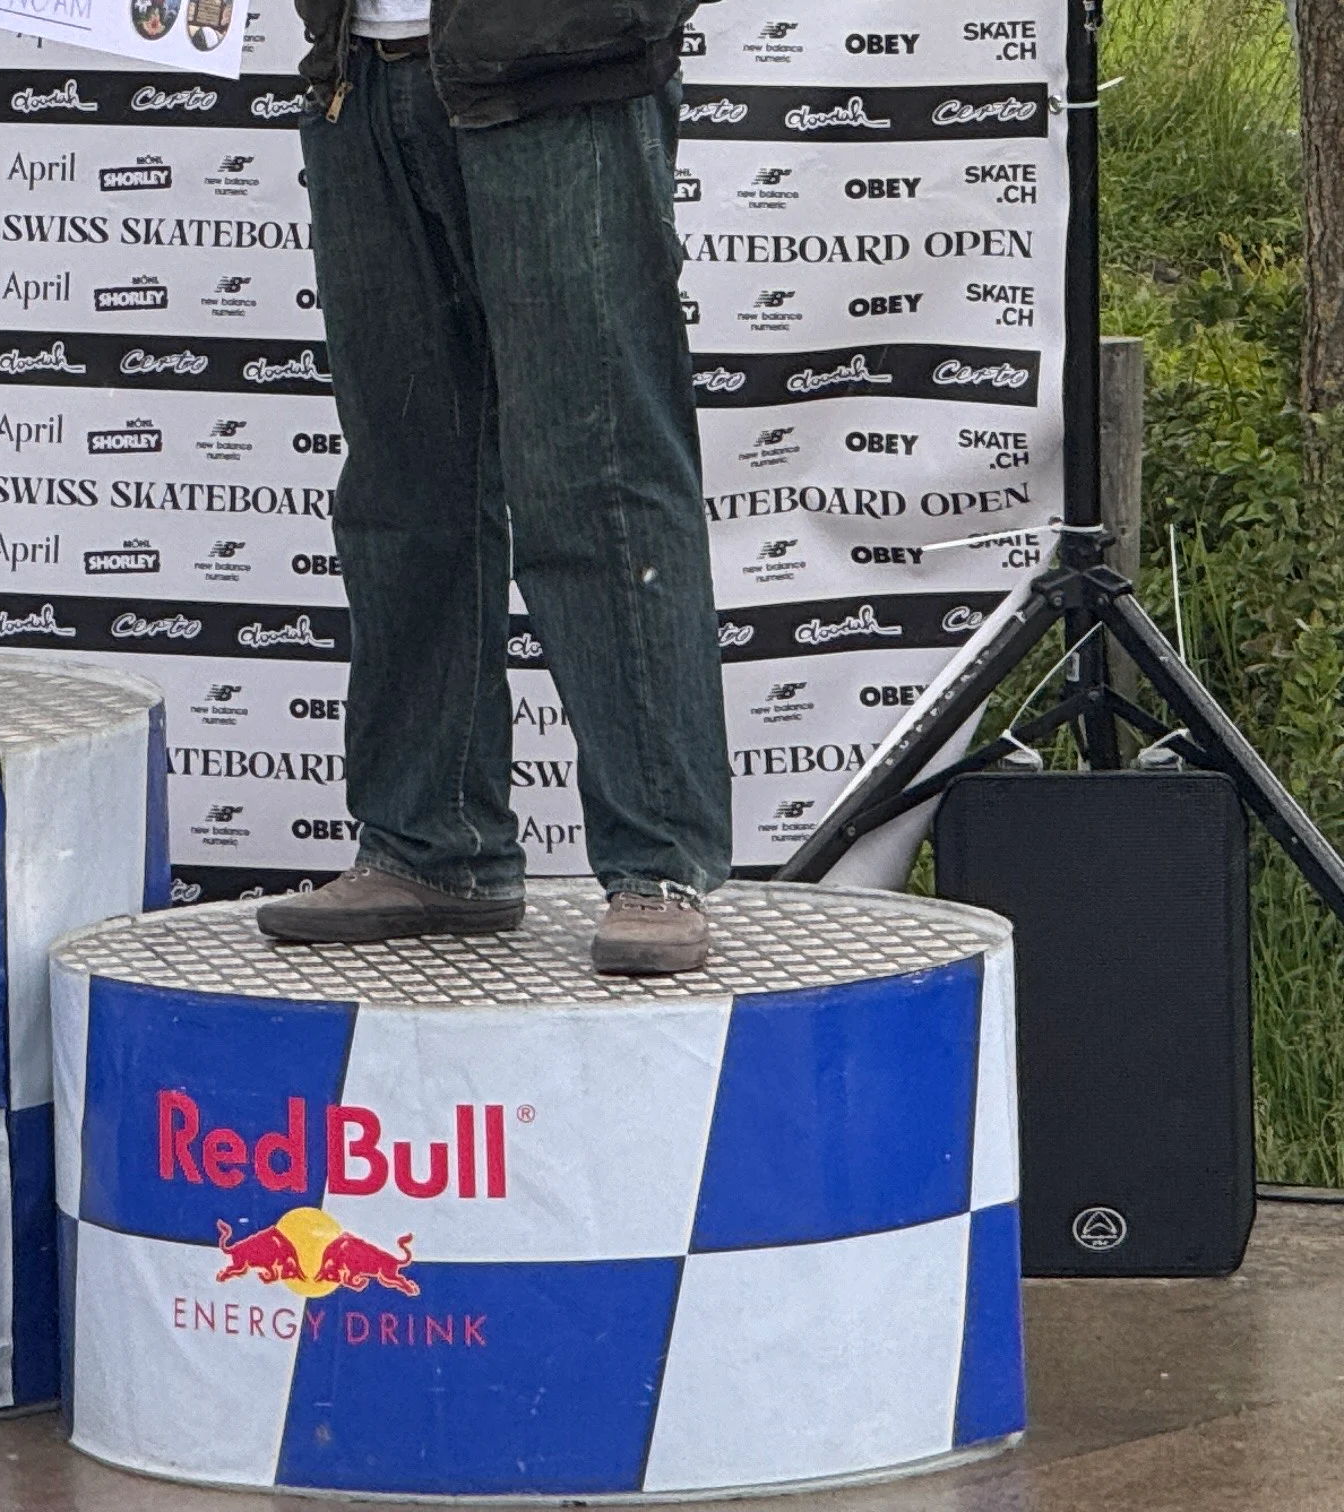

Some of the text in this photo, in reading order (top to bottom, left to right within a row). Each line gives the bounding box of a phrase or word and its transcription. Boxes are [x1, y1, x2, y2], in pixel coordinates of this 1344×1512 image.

[963, 21, 1036, 41] SKATE
[845, 33, 920, 54] OBEY
[996, 43, 1037, 61] .CH
[130, 86, 217, 110] Certo
[932, 97, 1037, 127] Certo
[7, 152, 75, 190] April
[103, 170, 167, 187] SHORLEY
[965, 164, 1037, 184] SKATE
[845, 178, 921, 199] OBEY
[996, 185, 1037, 204] .CH
[2, 214, 109, 243] SWISS
[679, 230, 1033, 265] KATEBOARD OPEN
[2, 271, 70, 310] April
[99, 291, 163, 306] SHORLEY
[966, 283, 1035, 305] SKATE
[848, 293, 923, 317] OBEY
[995, 307, 1034, 327] .CH
[932, 360, 1028, 388] Certo
[91, 434, 158, 451] SHORLEY
[845, 432, 919, 455] OBEY
[958, 429, 1028, 450] SKATE
[989, 451, 1029, 470] .CH
[920, 482, 1030, 518] OPEN
[88, 554, 157, 572] SHORLEY
[111, 612, 202, 639] Certo
[291, 819, 364, 841] OBEY
[156, 1088, 507, 1199] Red Bull
[174, 1297, 487, 1347] ENERGY DRINK
